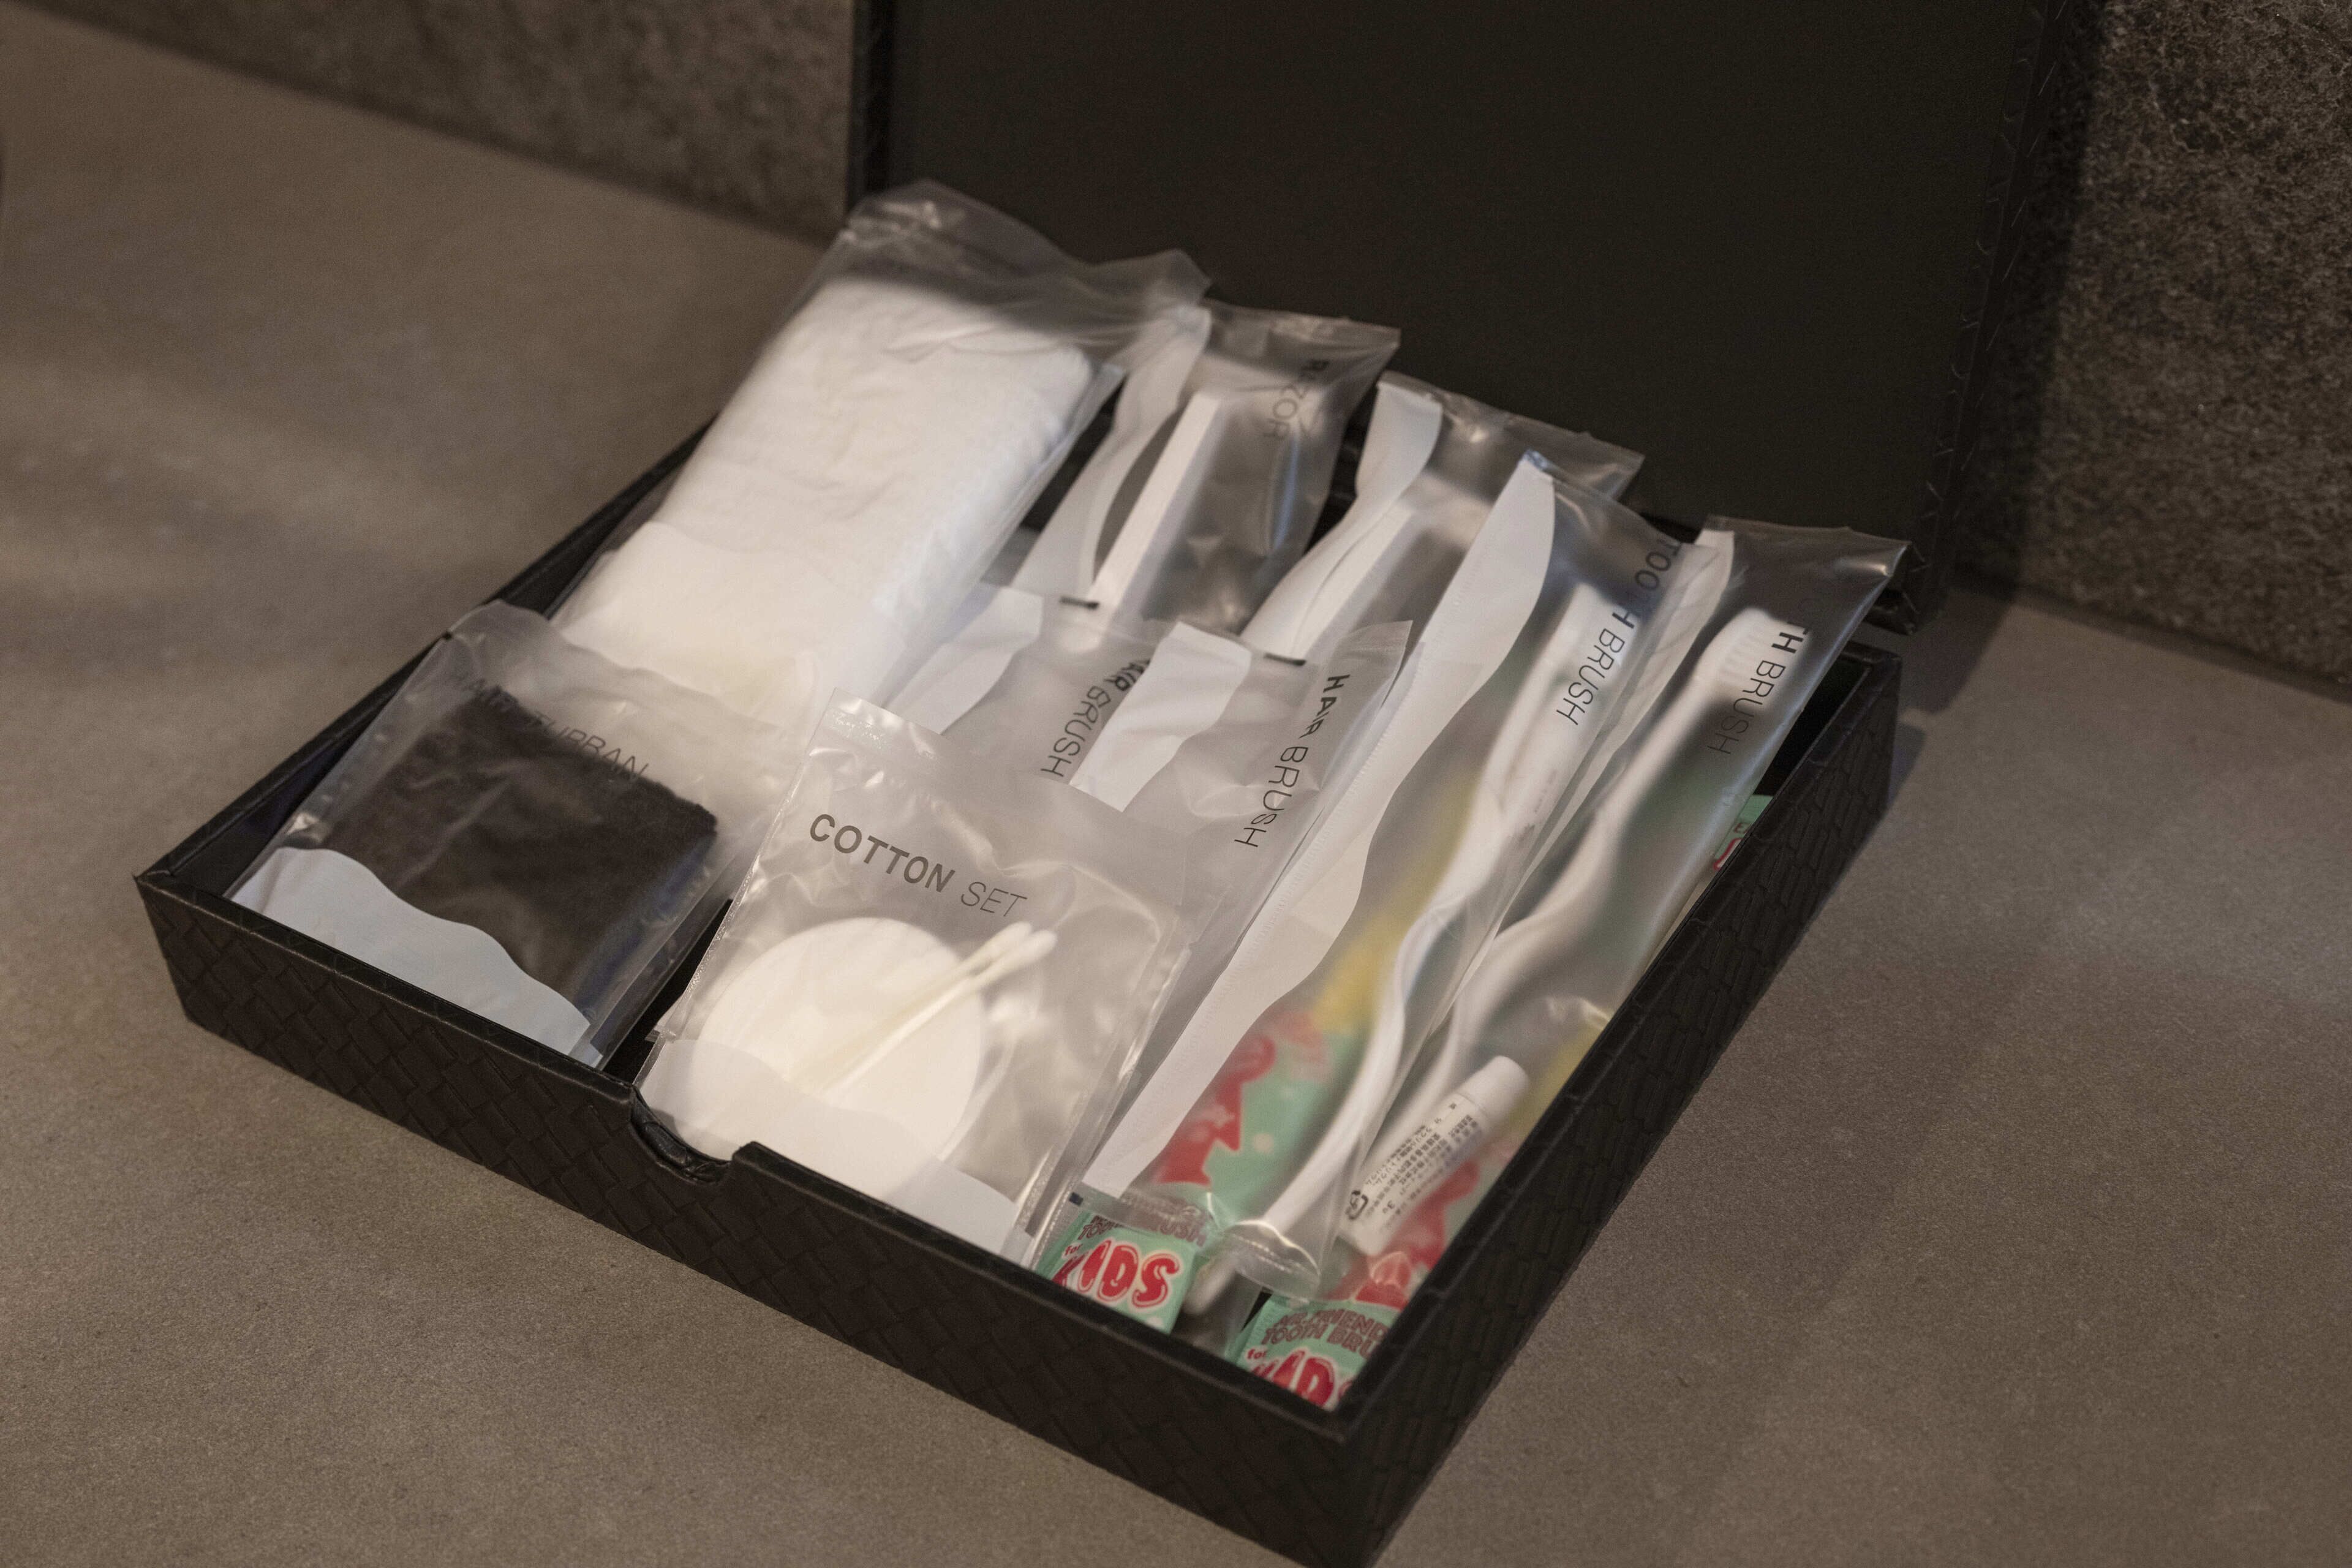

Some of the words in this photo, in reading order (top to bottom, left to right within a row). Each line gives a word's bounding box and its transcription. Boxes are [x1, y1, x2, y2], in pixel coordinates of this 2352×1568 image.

[1611, 538, 1682, 629] TOOH
[1104, 658, 1150, 691] AIR
[1298, 674, 1350, 739] HAIR
[1556, 628, 1626, 725] BRUSH
[1706, 659, 1786, 755] BRUSH
[1041, 685, 1110, 777] BRUSH
[1234, 746, 1308, 847] BRUSH
[810, 814, 956, 892] COTTON
[961, 881, 1028, 917] SET
[1065, 1243, 1083, 1256] for
[1261, 1323, 1330, 1345] TOOTH
[1327, 1328, 1379, 1358] BRU
